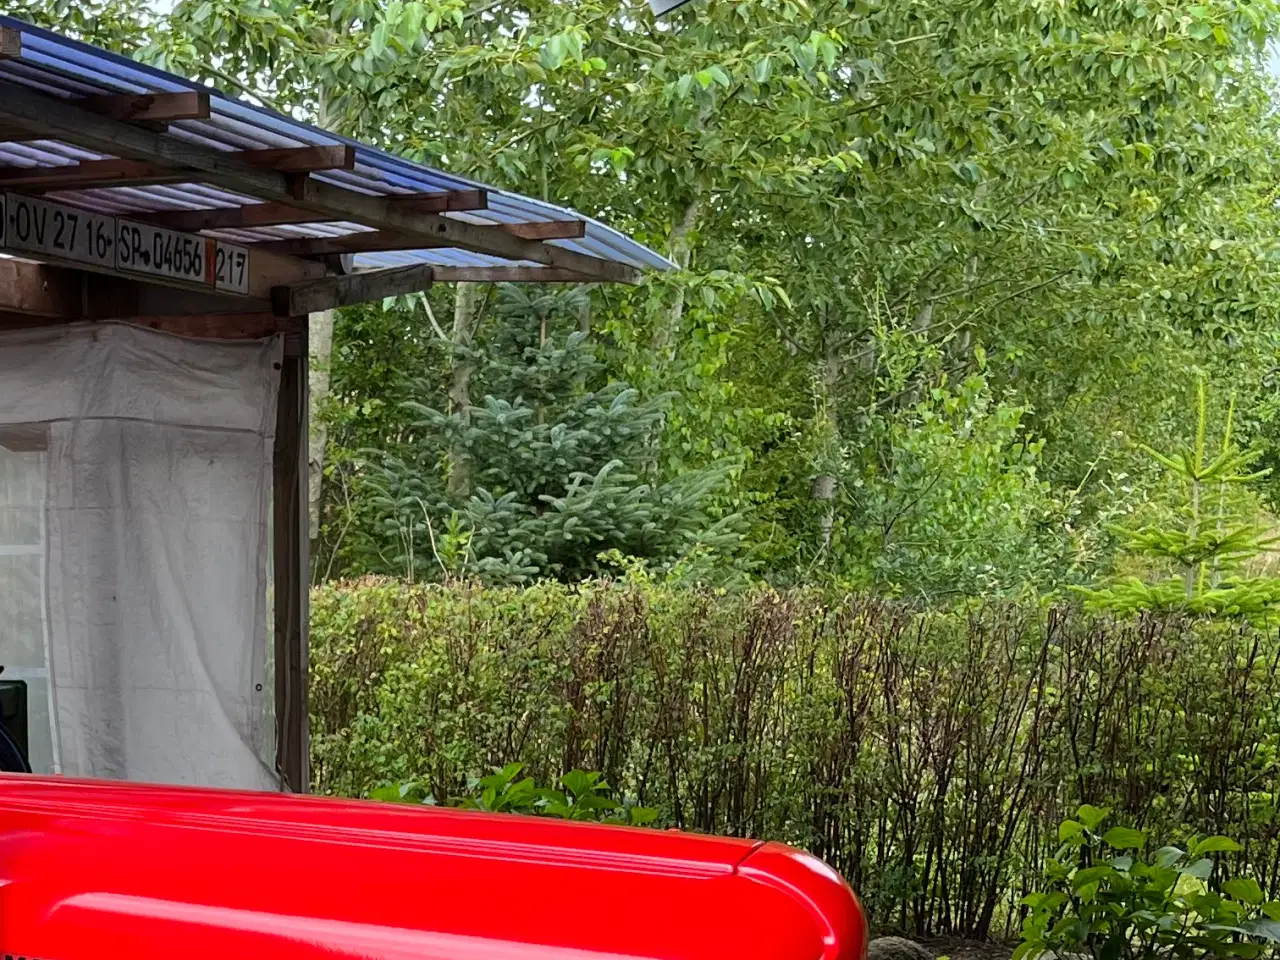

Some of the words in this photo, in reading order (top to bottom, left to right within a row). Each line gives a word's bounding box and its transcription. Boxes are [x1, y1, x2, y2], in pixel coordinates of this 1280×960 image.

[16, 203, 46, 245] OV
[53, 211, 78, 251] 27
[87, 220, 106, 259] 16
